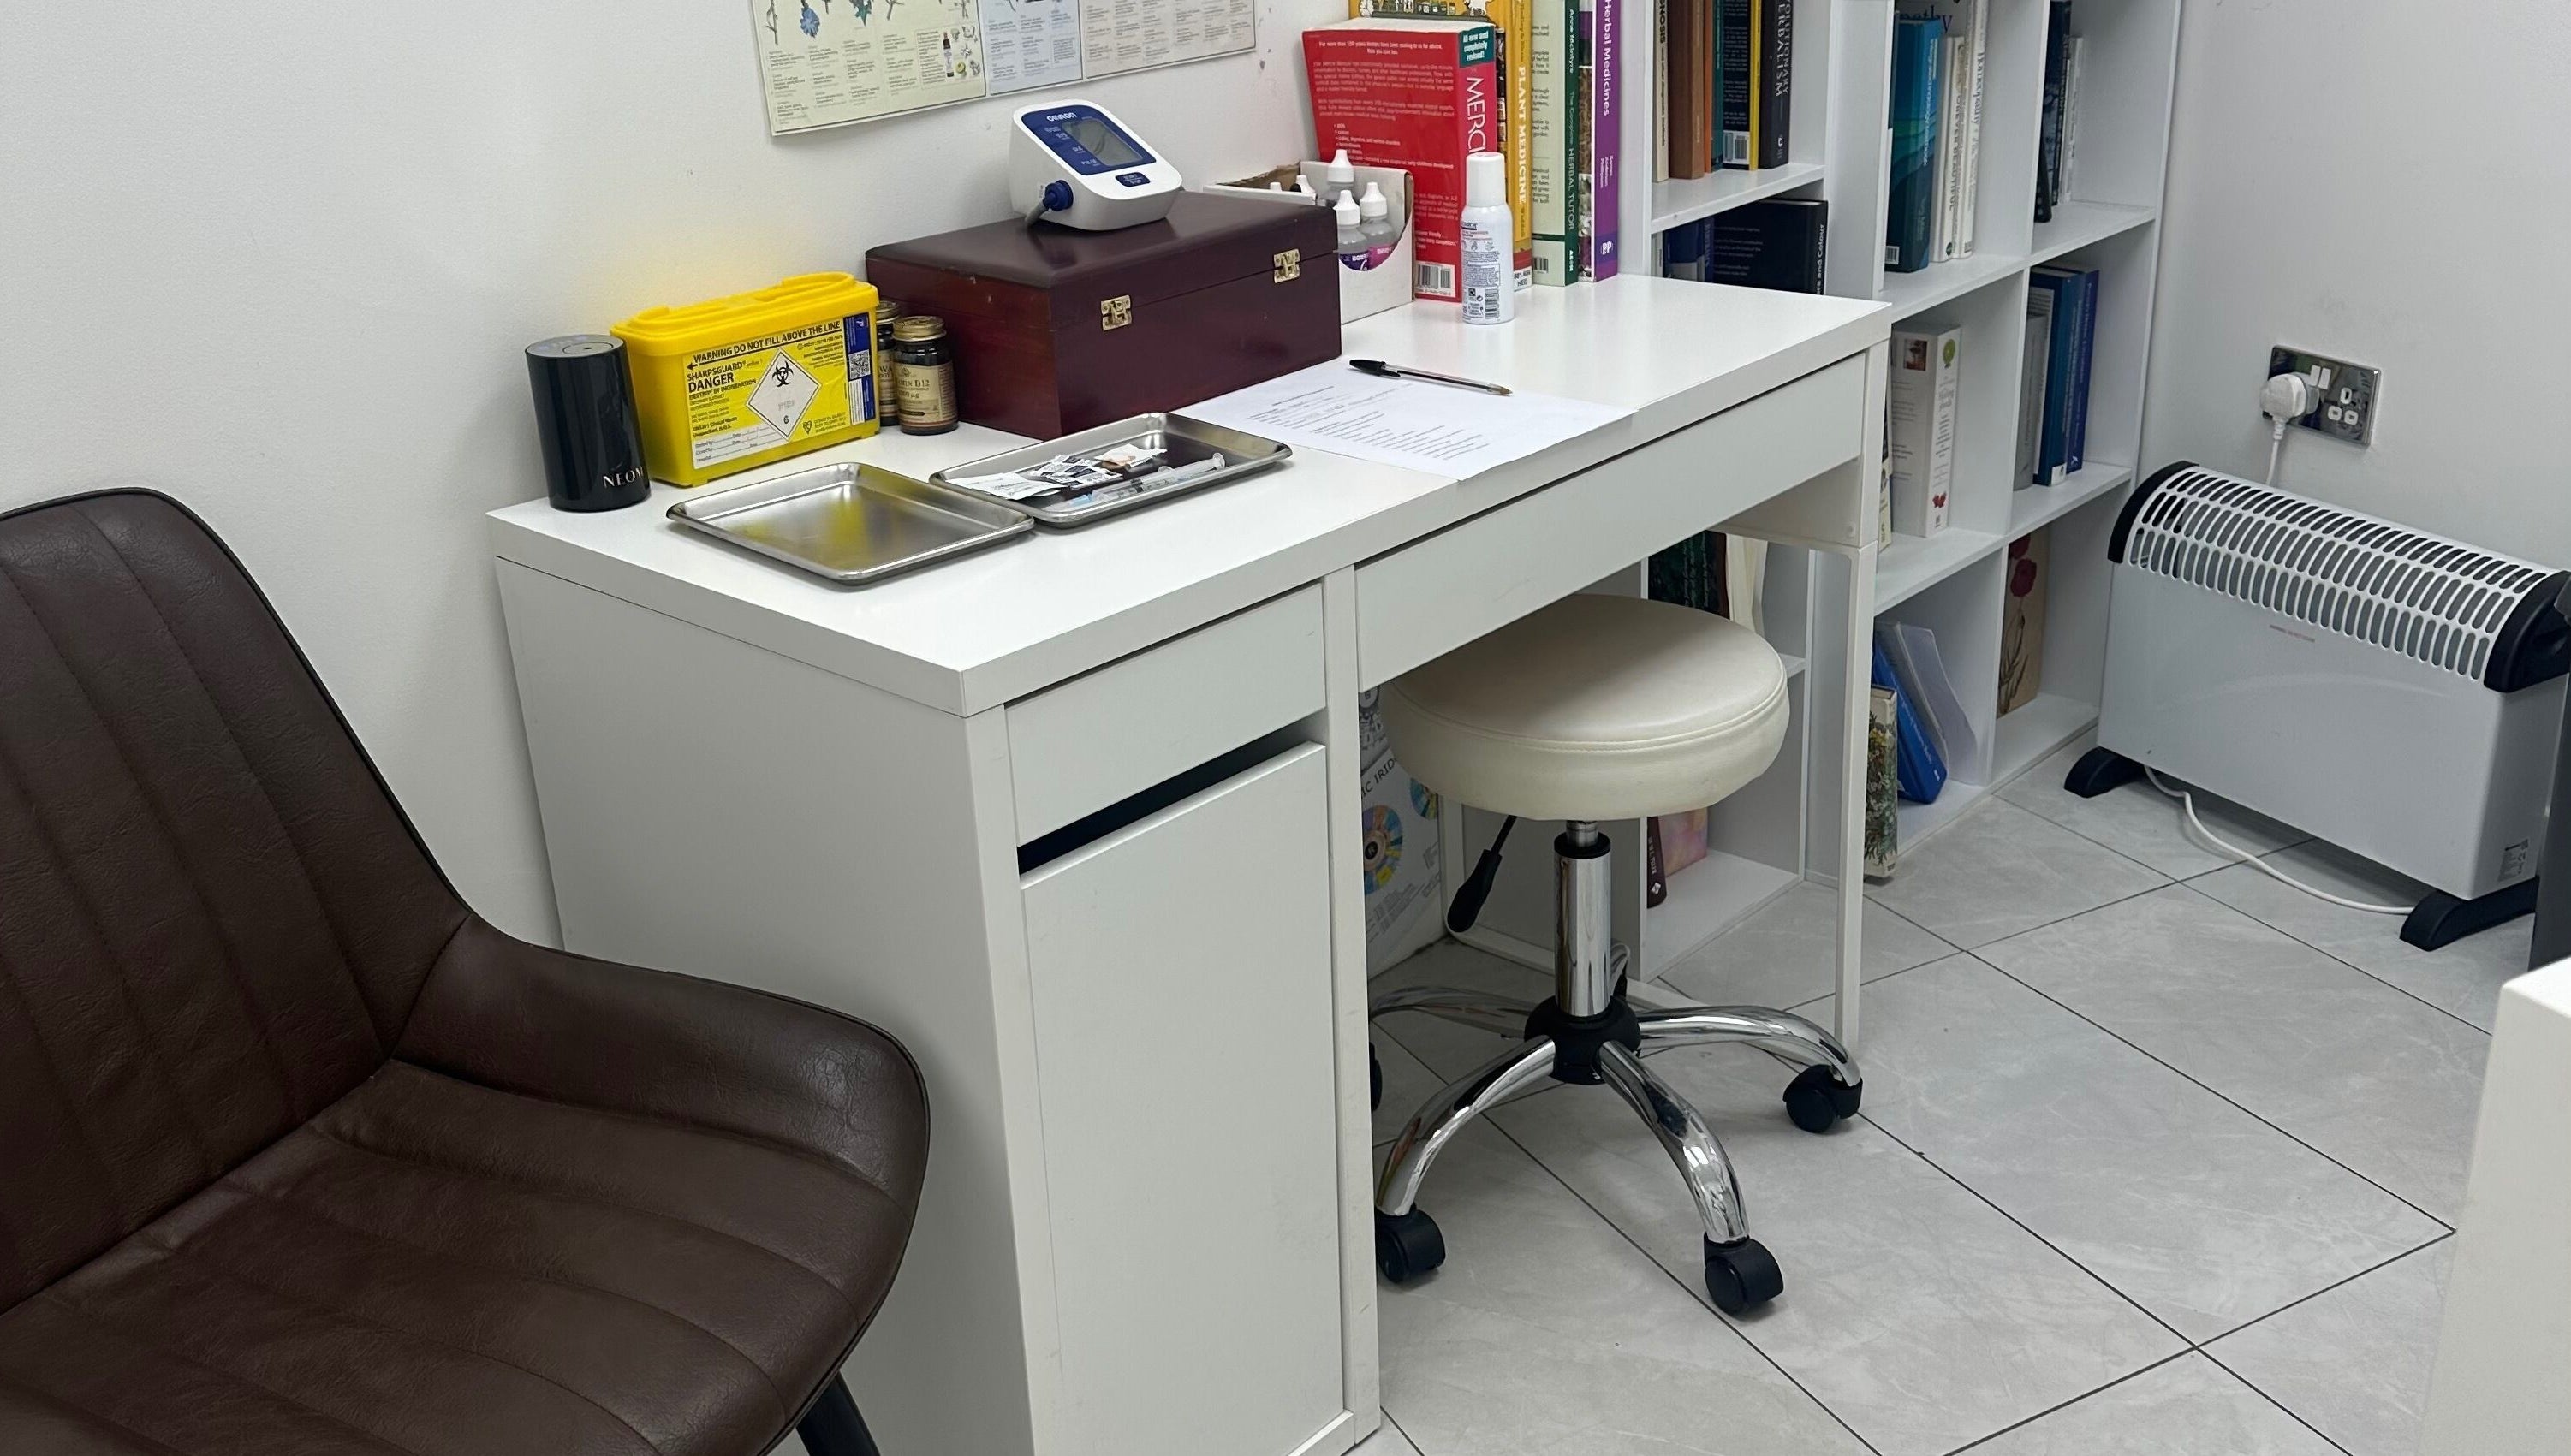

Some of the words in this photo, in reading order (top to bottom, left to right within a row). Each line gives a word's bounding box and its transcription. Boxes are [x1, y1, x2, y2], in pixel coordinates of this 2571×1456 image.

[1469, 33, 1479, 41] new
[1479, 30, 1489, 39] and
[1518, 67, 1527, 121] PLANT
[1047, 112, 1077, 122] OMRON
[1518, 126, 1527, 205] MEDICINE
[693, 347, 733, 363] WARNING
[734, 344, 747, 354] DO
[747, 340, 763, 350] NOT
[765, 336, 781, 346] FILL
[782, 329, 807, 342] ABOVE
[808, 325, 823, 336] THE
[824, 321, 841, 332] LINE
[688, 372, 734, 393] DANGER
[914, 379, 930, 388] B12
